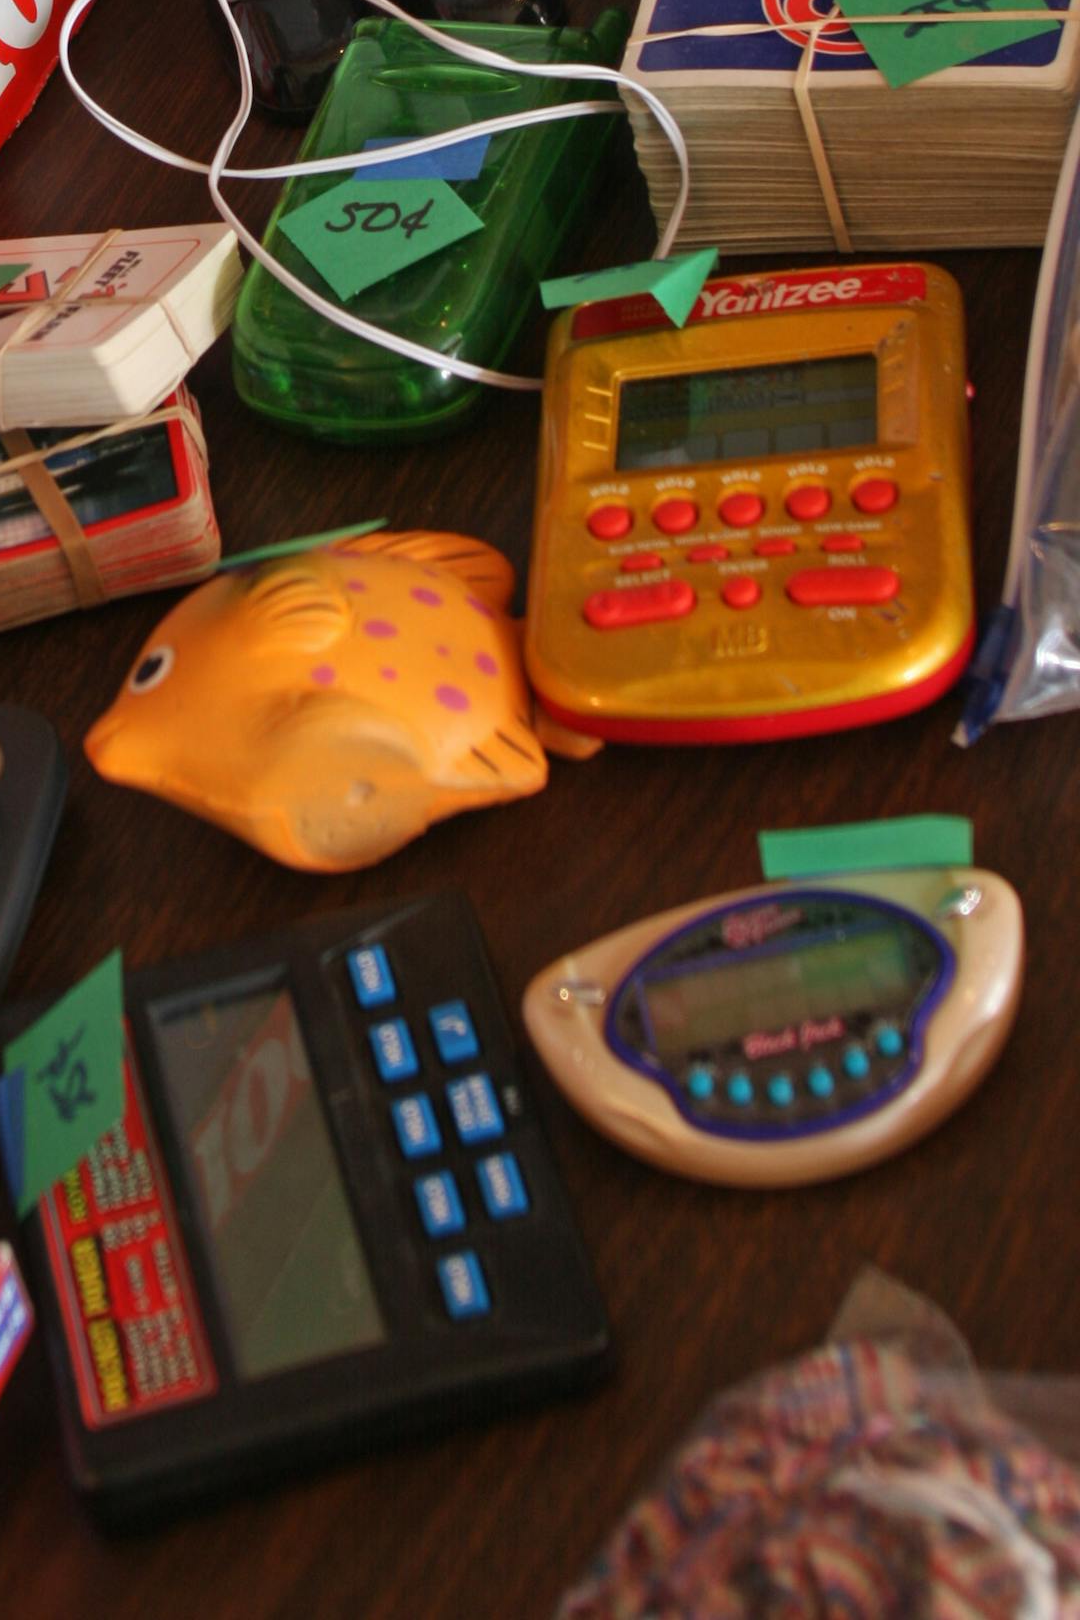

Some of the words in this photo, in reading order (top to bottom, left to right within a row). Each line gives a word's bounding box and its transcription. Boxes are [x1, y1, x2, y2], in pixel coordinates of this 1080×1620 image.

[788, 463, 827, 478] HOLD
[853, 455, 894, 471] HOLD
[655, 475, 695, 492] HOLD
[721, 470, 761, 485] HOLD
[589, 483, 629, 498] HOLD
[719, 560, 768, 574] ENTER
[828, 553, 867, 567] ROLL
[615, 570, 671, 586] SELECT
[828, 607, 856, 622] ON
